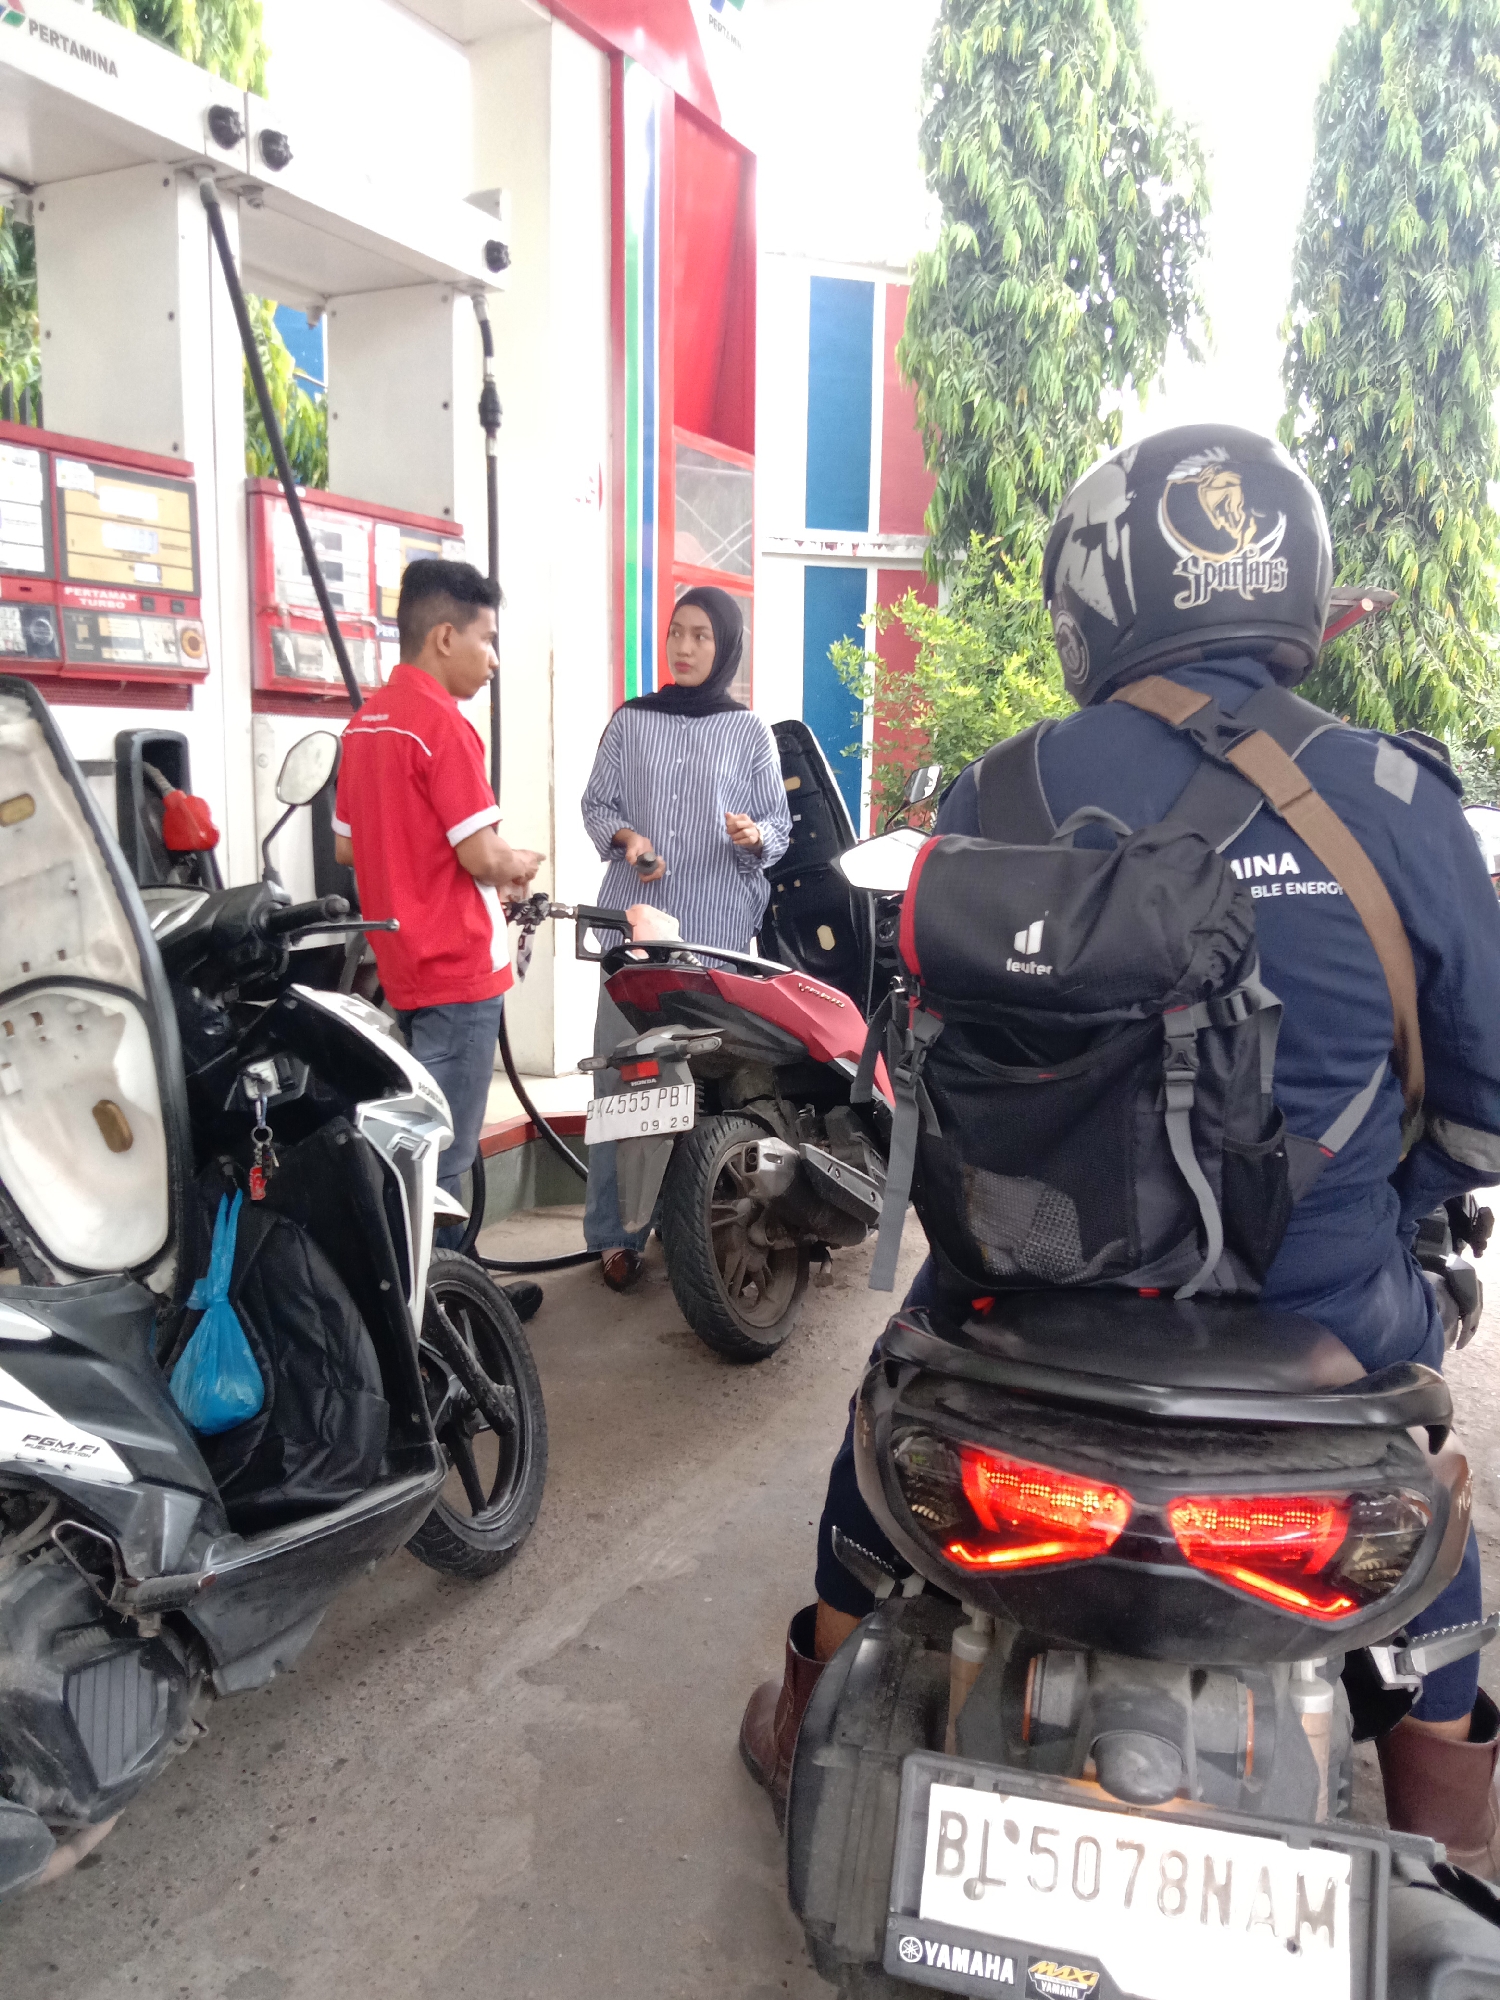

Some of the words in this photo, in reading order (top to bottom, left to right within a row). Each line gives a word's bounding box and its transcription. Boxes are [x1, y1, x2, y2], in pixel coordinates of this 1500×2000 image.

[28, 18, 118, 78] PERTAMINA
[1172, 543, 1289, 610] Spartans
[64, 586, 137, 602] PERTAMAX
[79, 598, 125, 610] TURBO
[605, 1090, 651, 1116] 4555
[657, 1084, 693, 1109] PBT
[640, 1119, 660, 1132] 09
[670, 1115, 690, 1129] 29
[385, 1131, 433, 1162] FI
[24, 1443, 47, 1451] FUEL
[49, 1447, 92, 1459] INJECTION
[935, 1809, 1007, 1888] BL
[1026, 1825, 1190, 1919] 5078
[1199, 1853, 1340, 1949] NAM
[924, 1940, 1015, 1985] YAMAHA
[1041, 1980, 1079, 1999] YAMAHA
